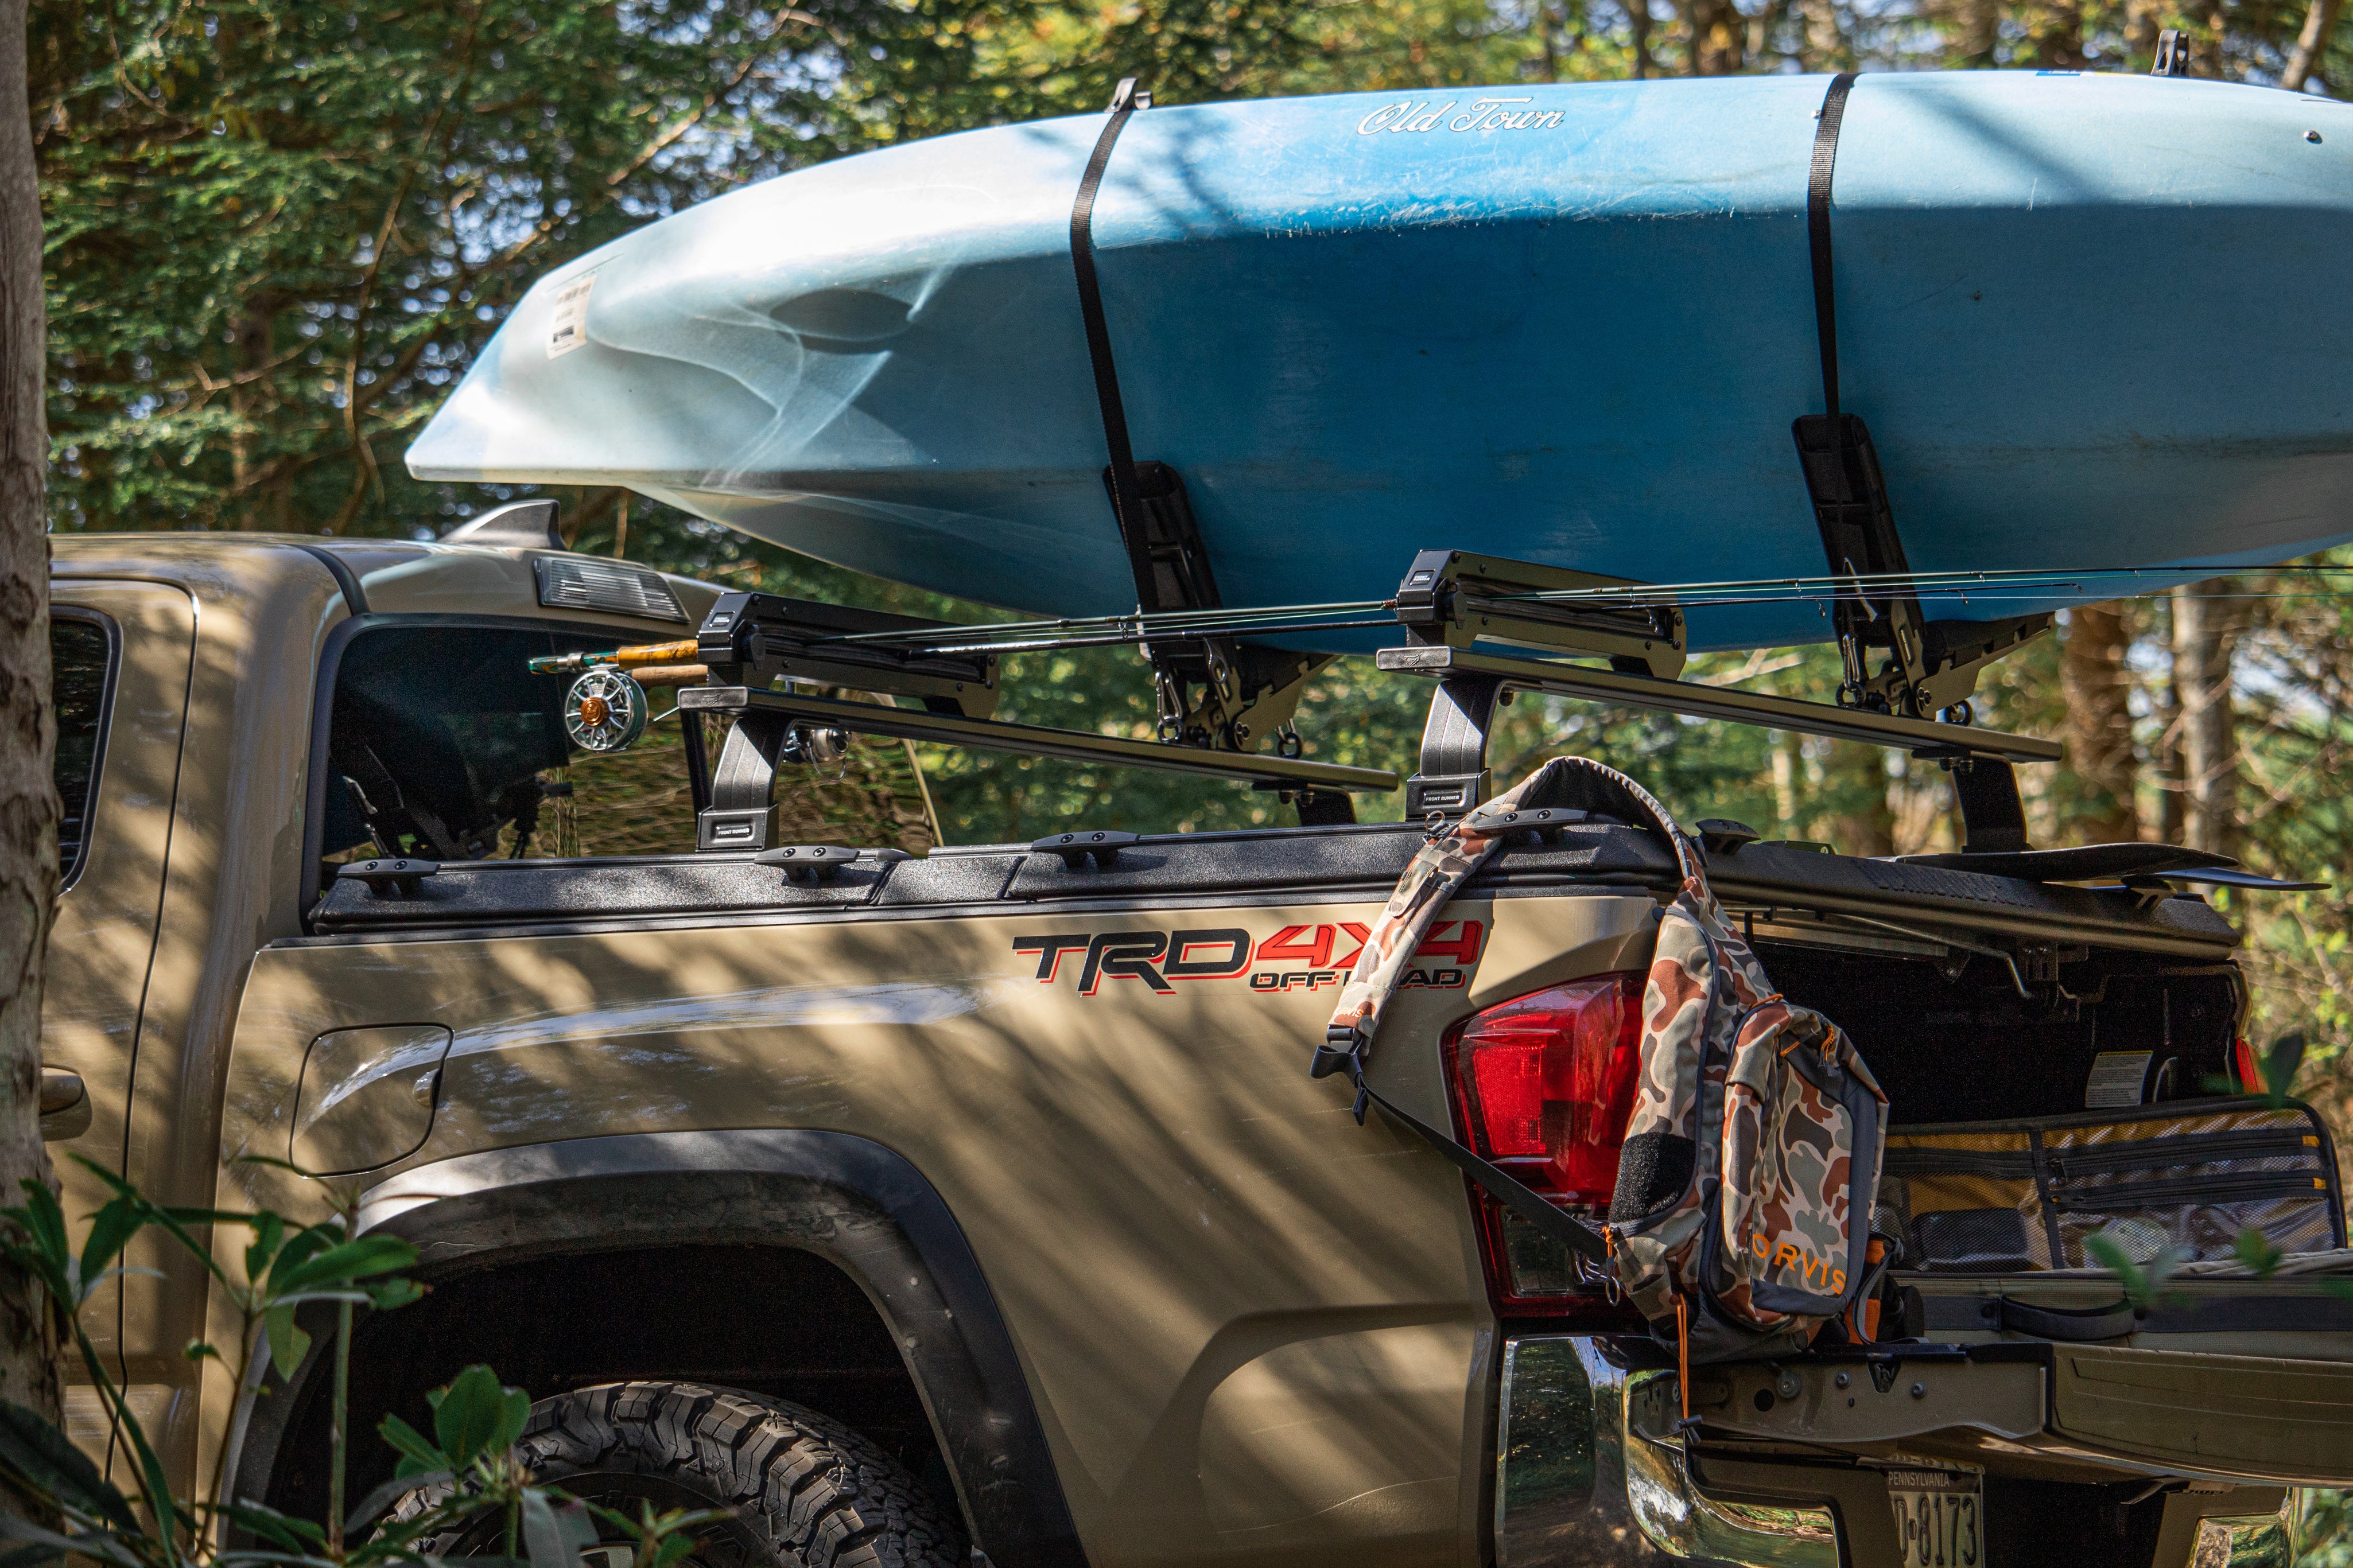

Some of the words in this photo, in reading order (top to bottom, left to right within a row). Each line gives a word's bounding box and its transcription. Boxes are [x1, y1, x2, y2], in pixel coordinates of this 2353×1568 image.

[1357, 100, 1458, 136] Old
[1449, 96, 1566, 133] Town
[1012, 928, 1255, 997] TRD
[1249, 971, 1339, 992] OFF
[1752, 1233, 1846, 1295] ORVIS
[1888, 1471, 1950, 1487] PENNSYLVANIA
